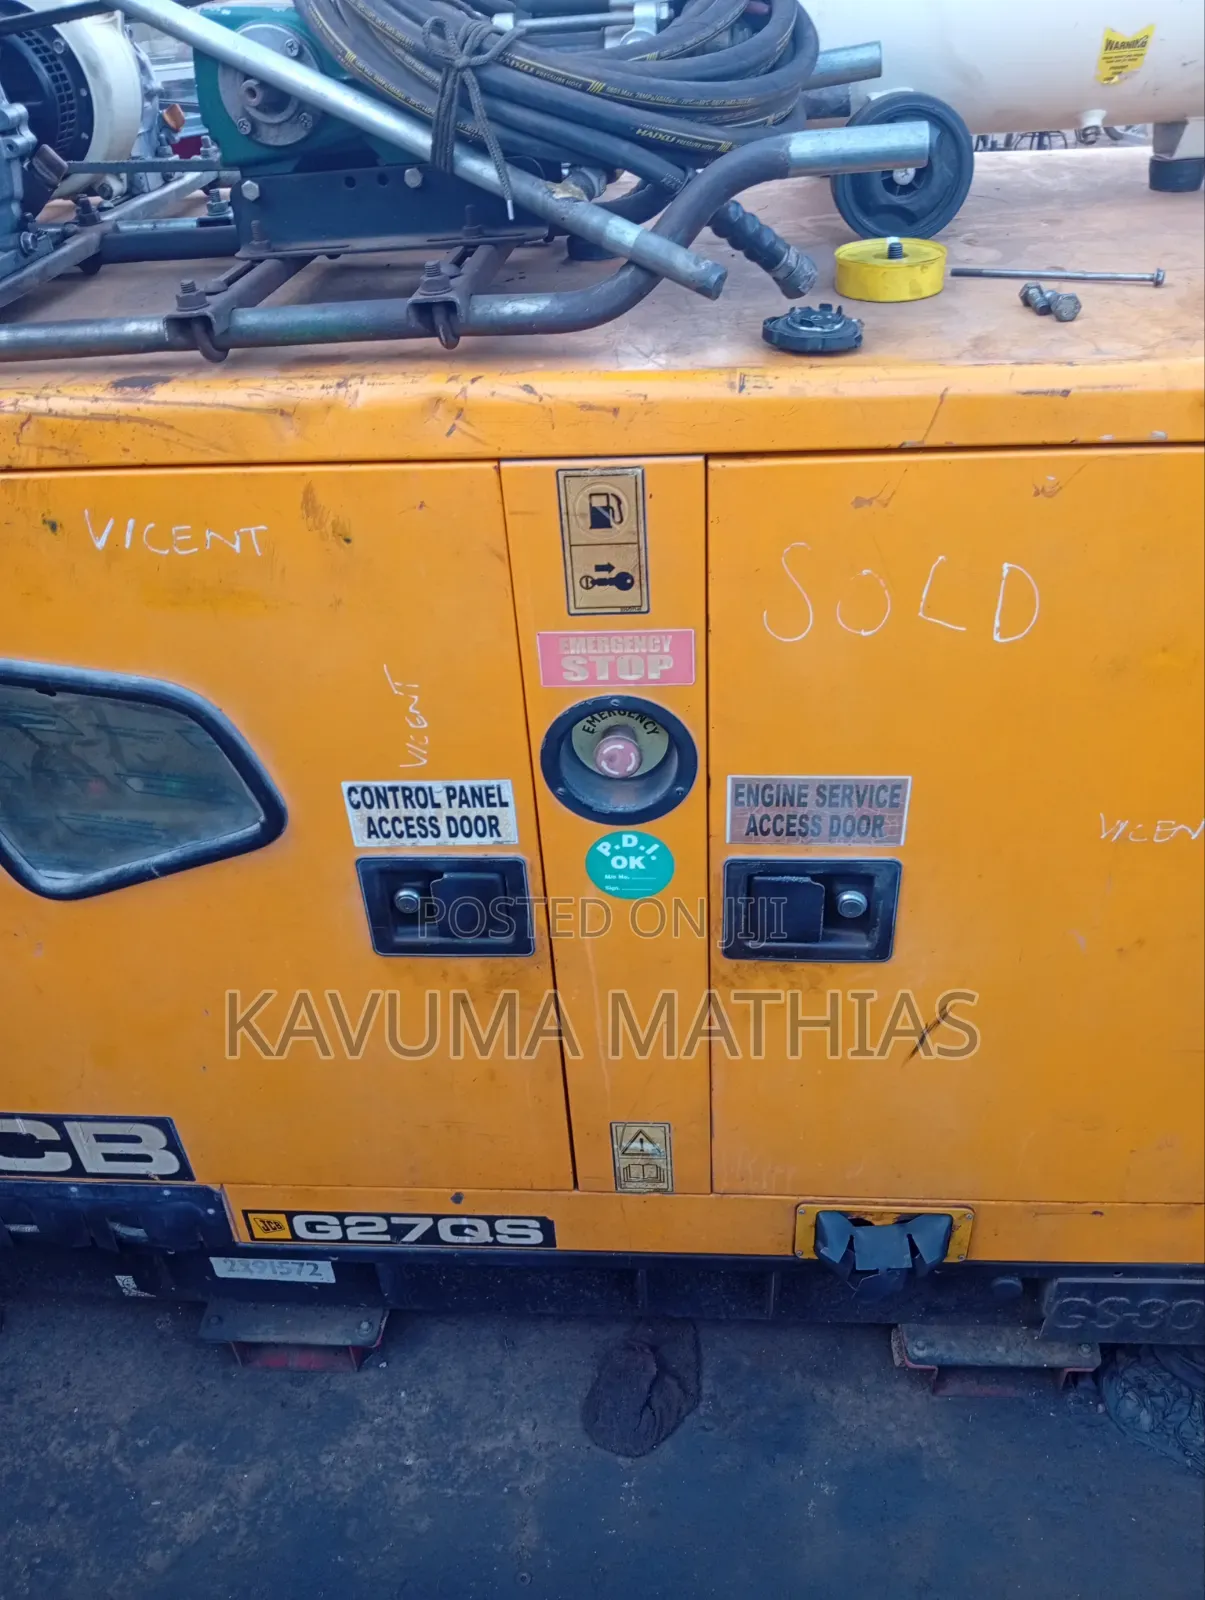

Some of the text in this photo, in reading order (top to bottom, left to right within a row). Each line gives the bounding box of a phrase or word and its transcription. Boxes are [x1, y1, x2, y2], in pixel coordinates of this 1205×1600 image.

[83, 508, 268, 556] VICENT
[763, 541, 1040, 643] SOLD
[559, 635, 673, 654] EMERGENCY
[561, 655, 674, 682] STOP
[582, 710, 660, 735] EMERGENCY
[347, 784, 509, 810] CONTROL PANEL
[734, 783, 902, 809] ENGINE SERVICE
[367, 814, 502, 839] ACCESS DOOR
[745, 814, 885, 838] ACCESS DOOR
[610, 855, 646, 870] OK
[260, 1219, 283, 1232] JCB
[292, 1215, 544, 1245] G27QS
